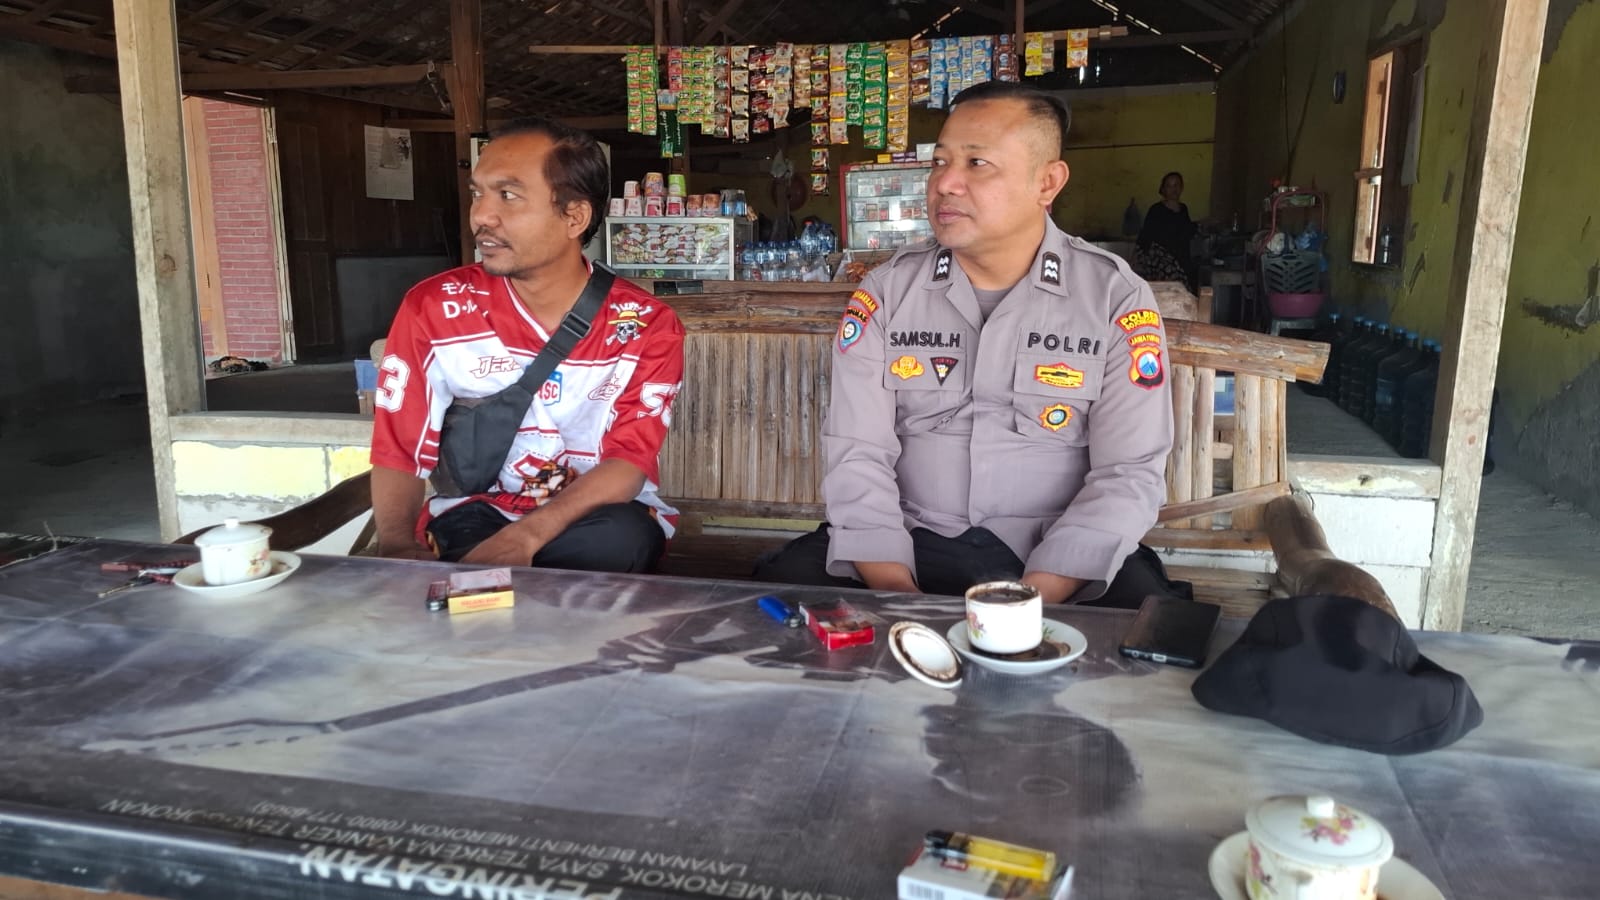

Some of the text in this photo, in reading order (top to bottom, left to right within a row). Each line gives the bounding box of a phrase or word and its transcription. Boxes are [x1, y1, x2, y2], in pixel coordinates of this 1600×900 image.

[890, 331, 960, 348] SAMSUL.H
[1027, 332, 1100, 355] POLRI
[375, 354, 411, 412] 3
[100, 799, 289, 836] TENOROKAN
[292, 824, 404, 851] KANKER
[404, 823, 519, 847] MEROKOK
[405, 838, 529, 870] TERKENA
[520, 837, 637, 863] BERHENTI
[537, 855, 609, 878] SAYA
[640, 851, 747, 878] LAYANAN
